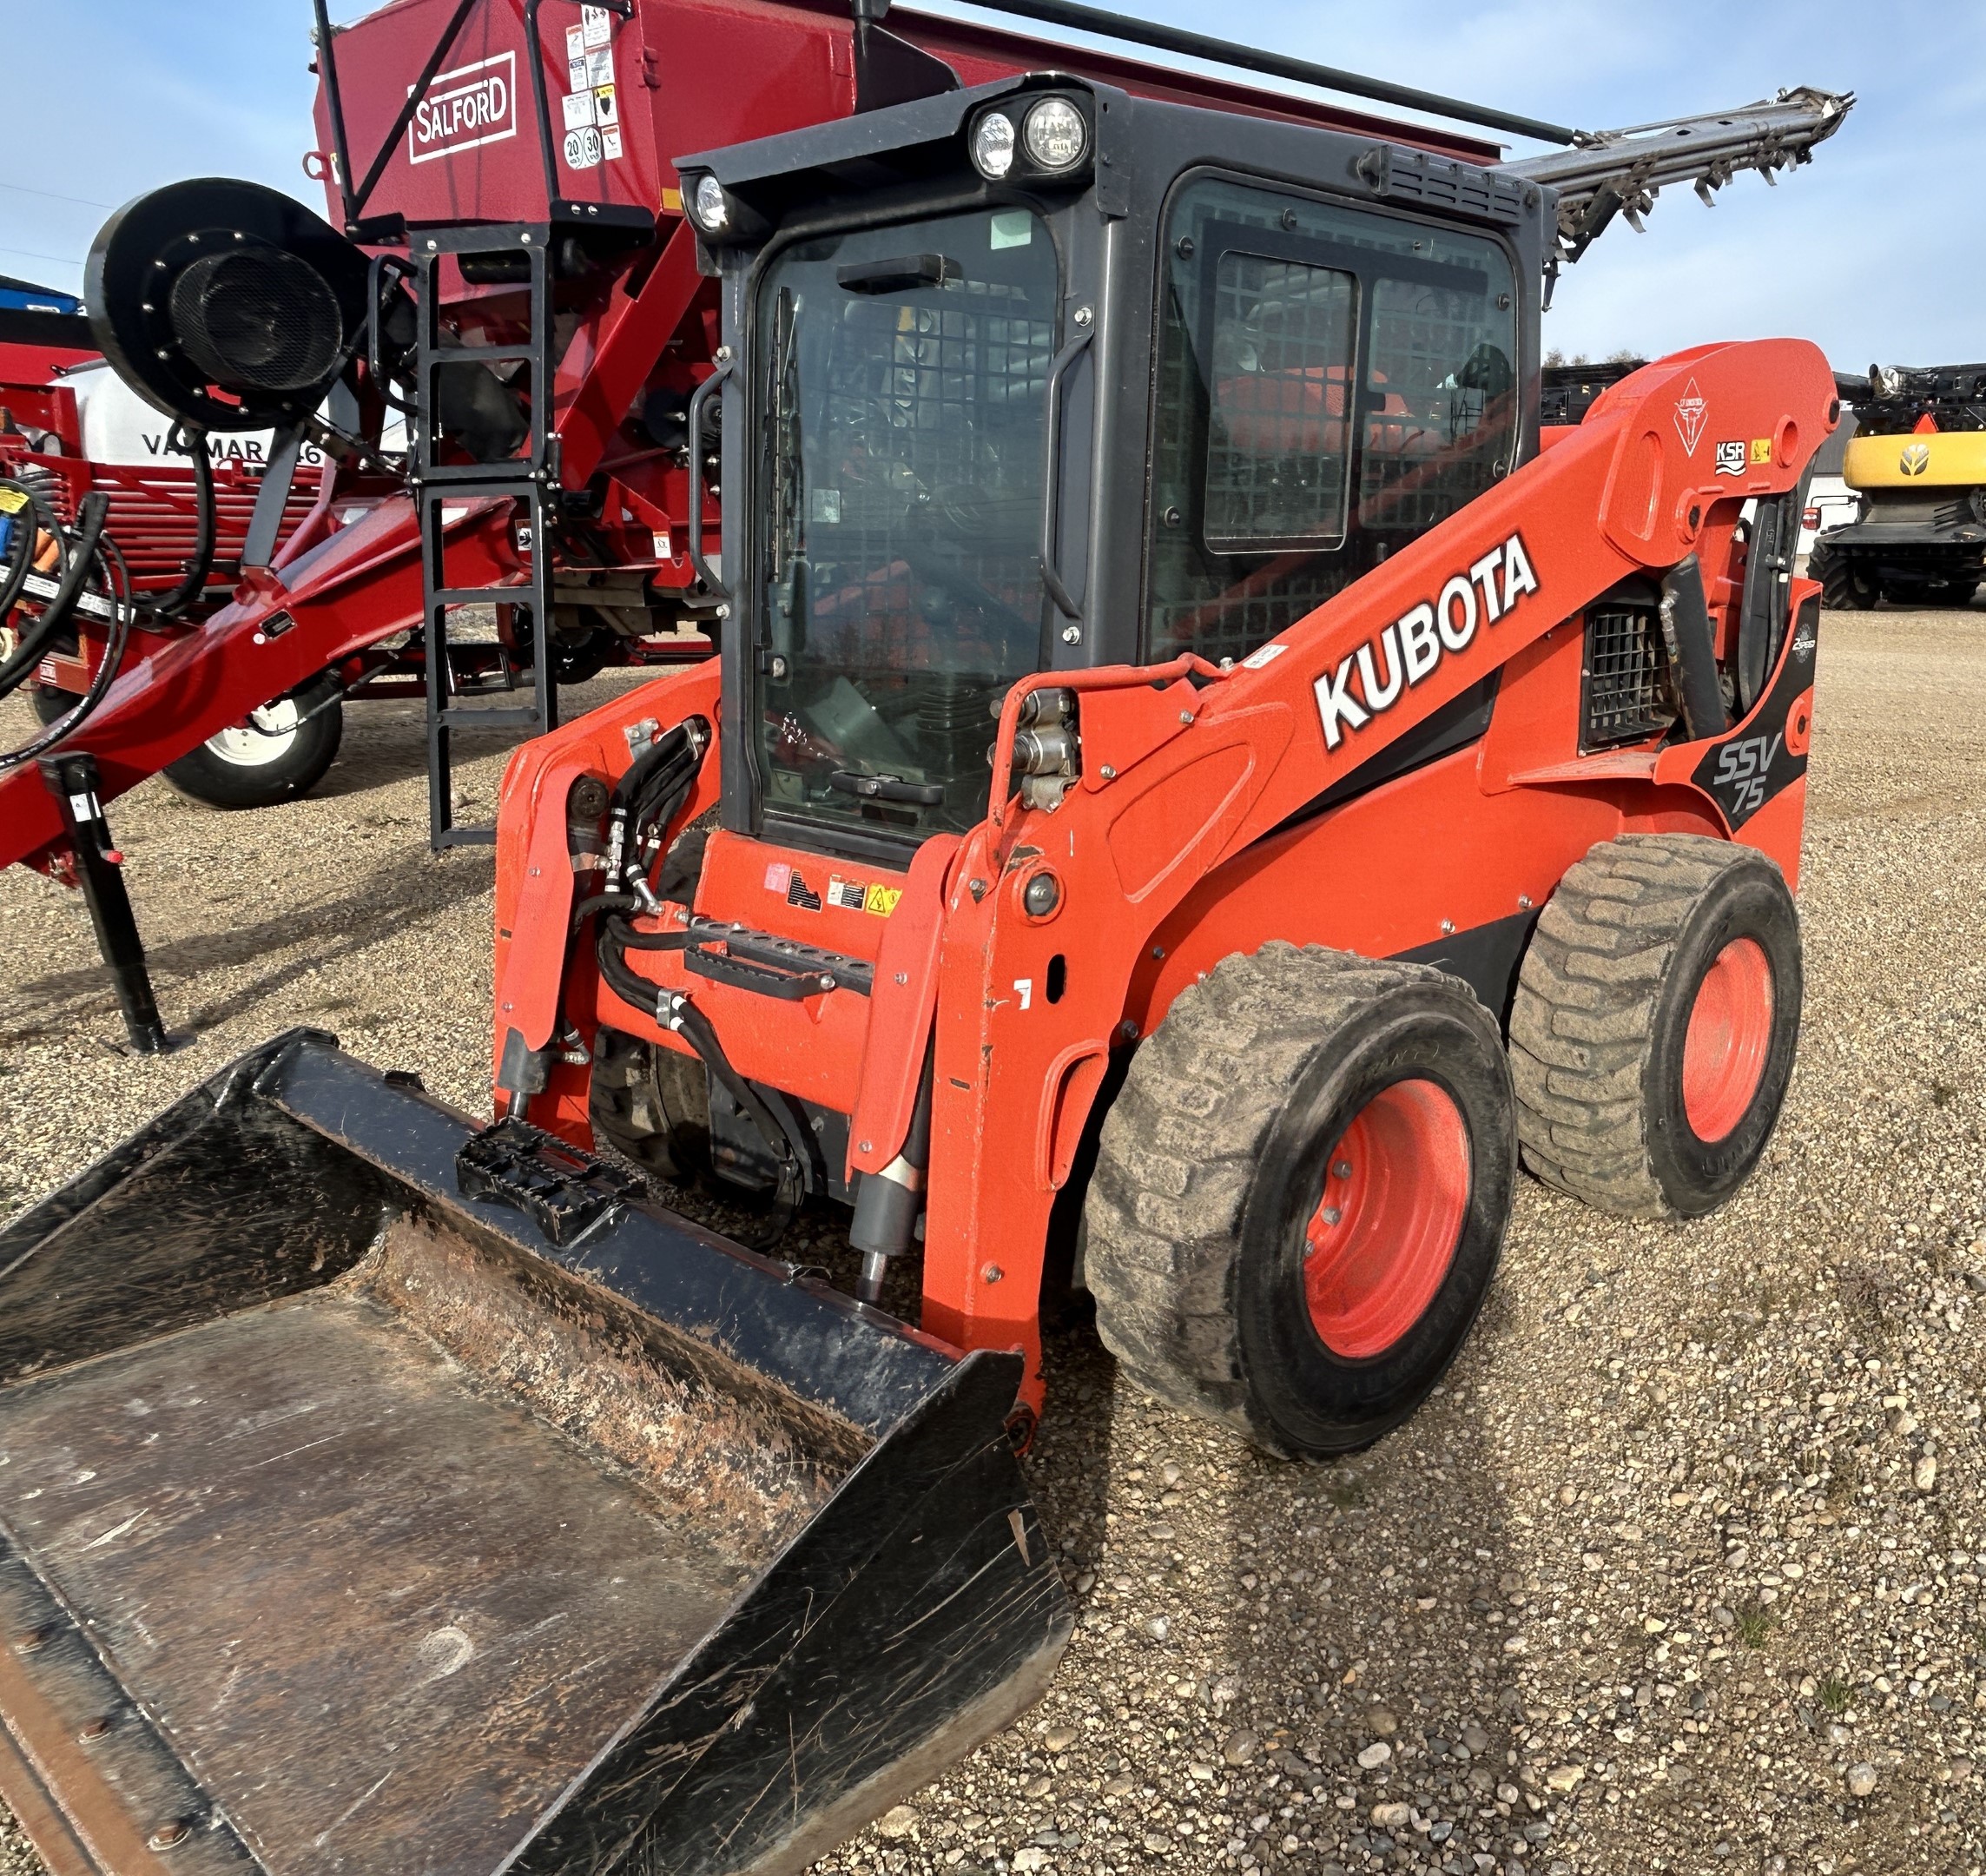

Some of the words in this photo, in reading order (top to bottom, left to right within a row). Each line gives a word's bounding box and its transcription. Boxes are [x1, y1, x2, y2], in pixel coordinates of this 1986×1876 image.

[417, 76, 507, 143] SALFORD
[567, 139, 579, 156] 20
[587, 133, 599, 152] 30
[1716, 442, 1745, 461] KSR
[1313, 533, 1538, 750] KUBOTA
[1712, 732, 1783, 785] SSV
[1732, 776, 1767, 814] 75
